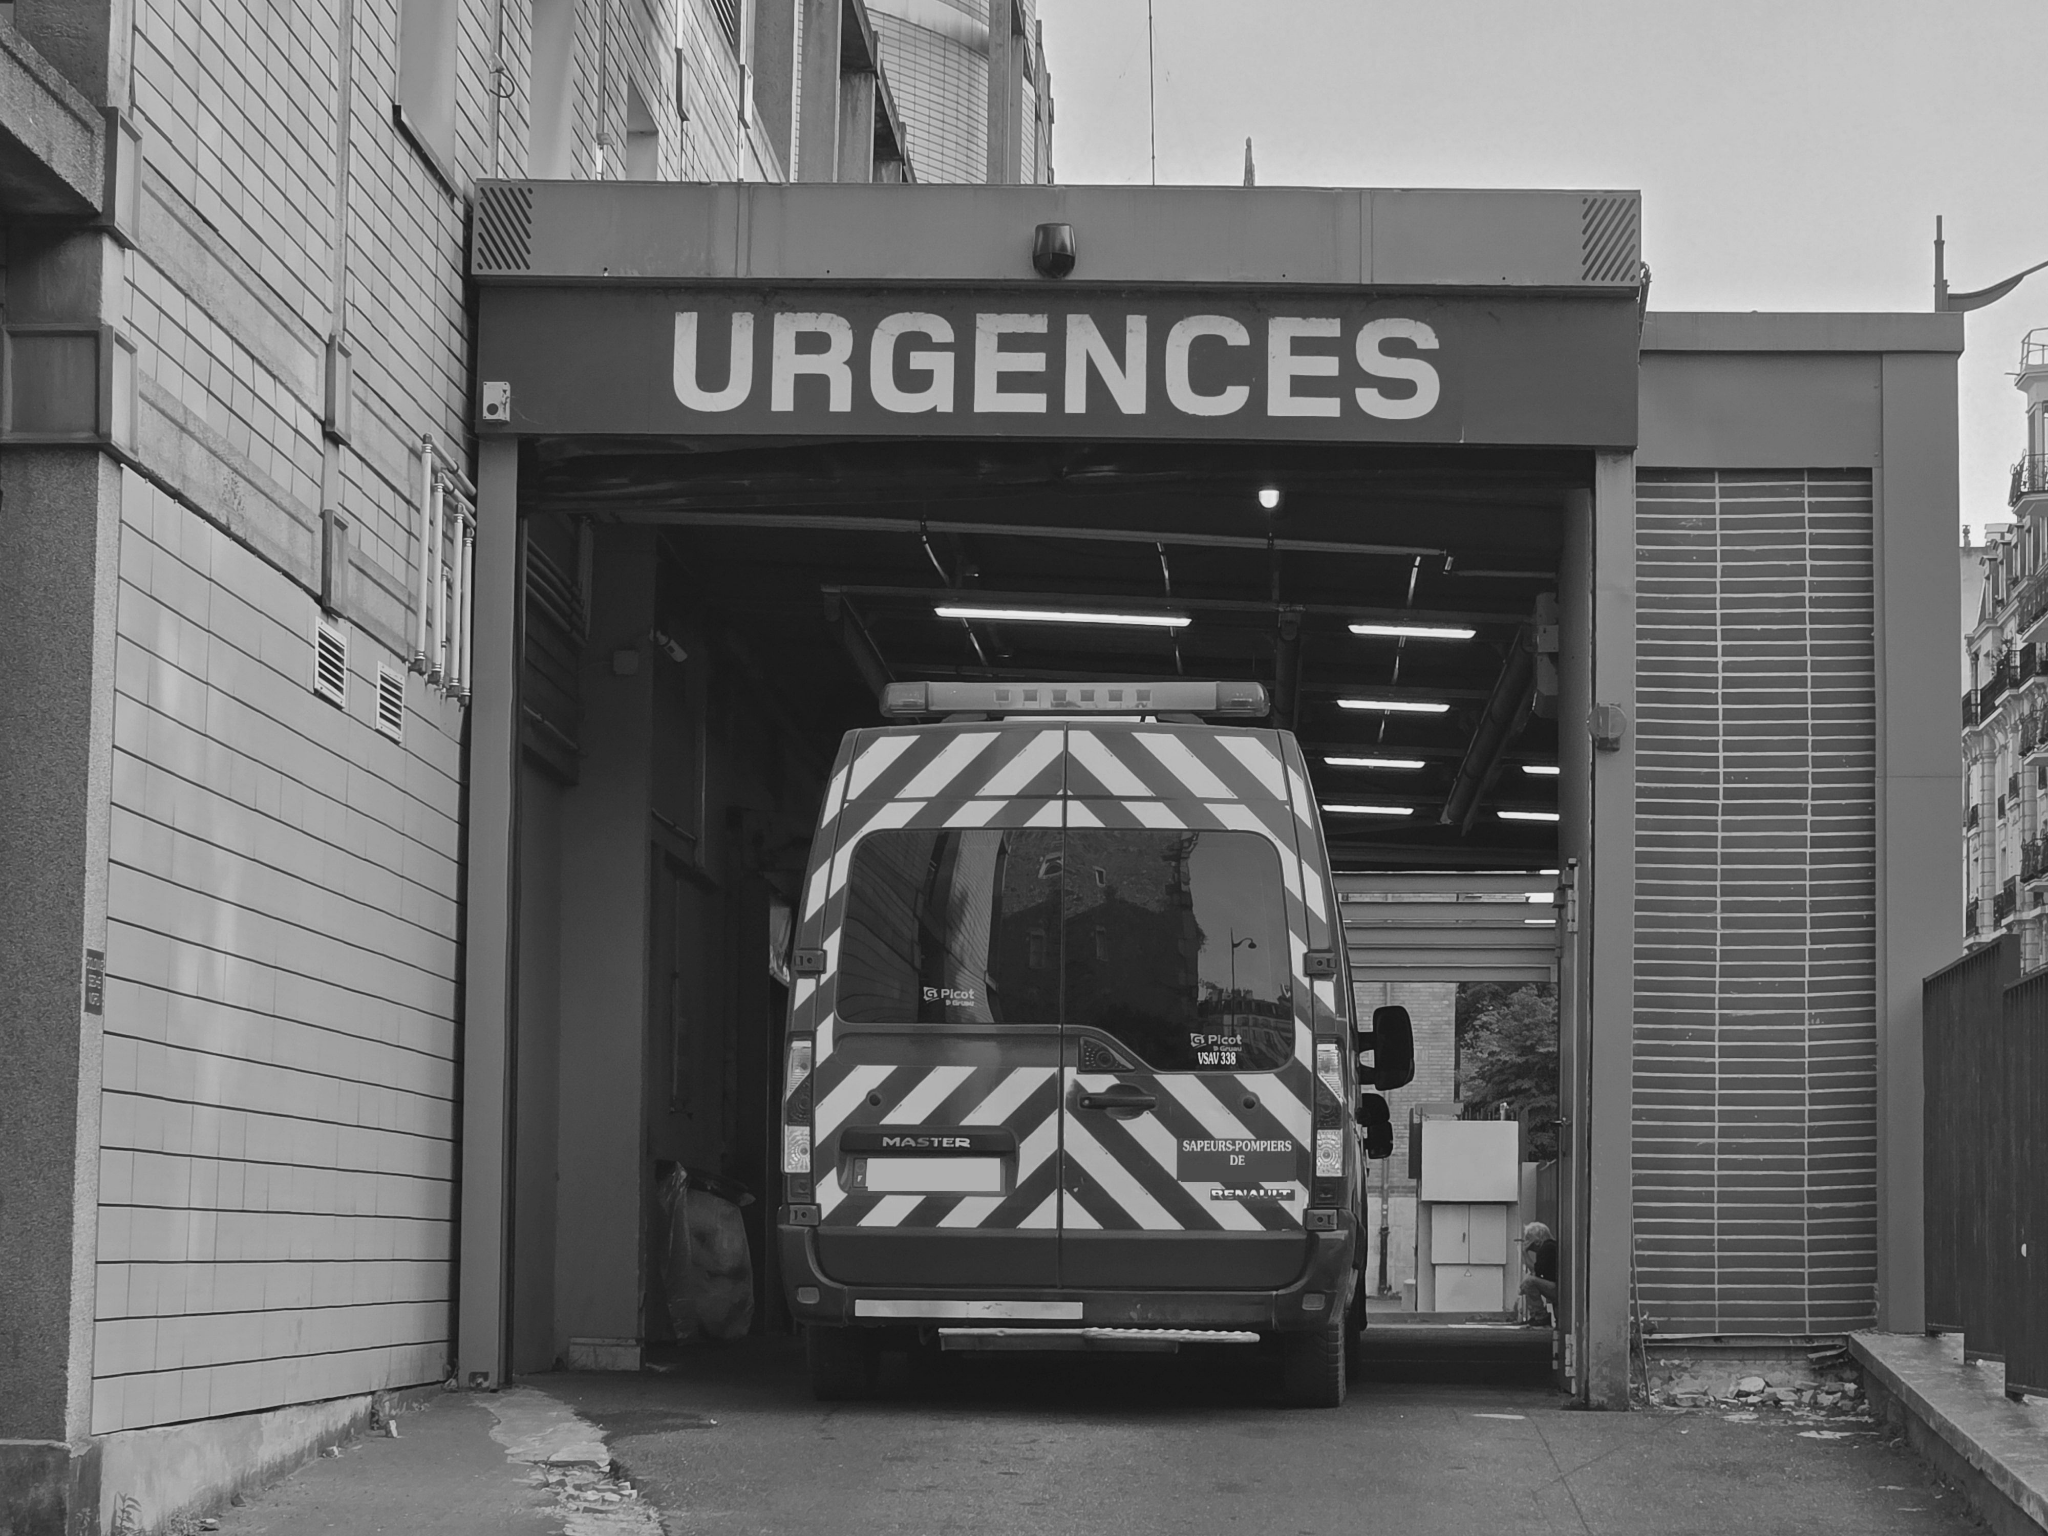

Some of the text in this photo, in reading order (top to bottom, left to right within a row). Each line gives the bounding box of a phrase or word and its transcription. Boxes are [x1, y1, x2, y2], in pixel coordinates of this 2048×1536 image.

[672, 311, 1441, 420] URGENCES
[940, 988, 975, 999] Picot
[1208, 1034, 1242, 1045] Picot
[1197, 1051, 1236, 1065] VSAV 338
[882, 1137, 970, 1148] MASTER
[1182, 1140, 1292, 1151] SAPEURS-POMPIERS
[1229, 1155, 1246, 1166] DE
[1211, 1189, 1291, 1199] RENAULT
